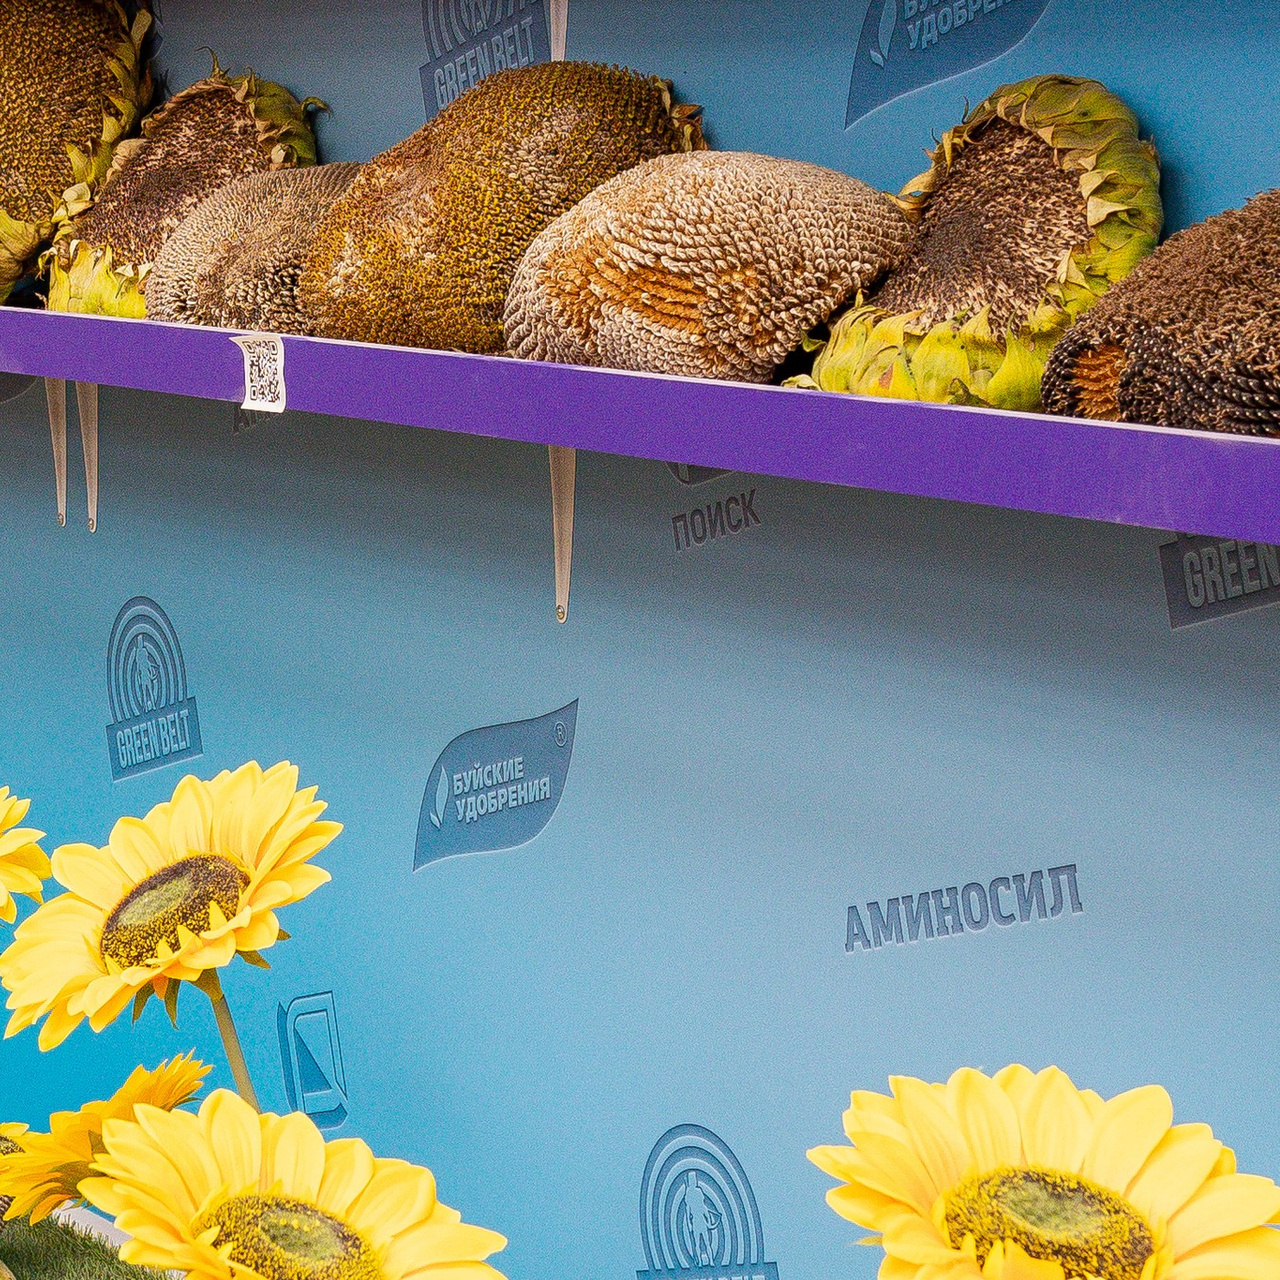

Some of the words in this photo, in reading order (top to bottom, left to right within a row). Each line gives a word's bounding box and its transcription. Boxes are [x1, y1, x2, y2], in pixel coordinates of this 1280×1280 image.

[671, 488, 761, 551] ПОИСК
[116, 720, 161, 769] GREEN
[158, 709, 192, 756] BELT
[453, 757, 525, 795] БУЙСКИЕ
[455, 775, 552, 823] УДОБРЕНИЯ
[845, 864, 1084, 953] АМИНОСИЛ
